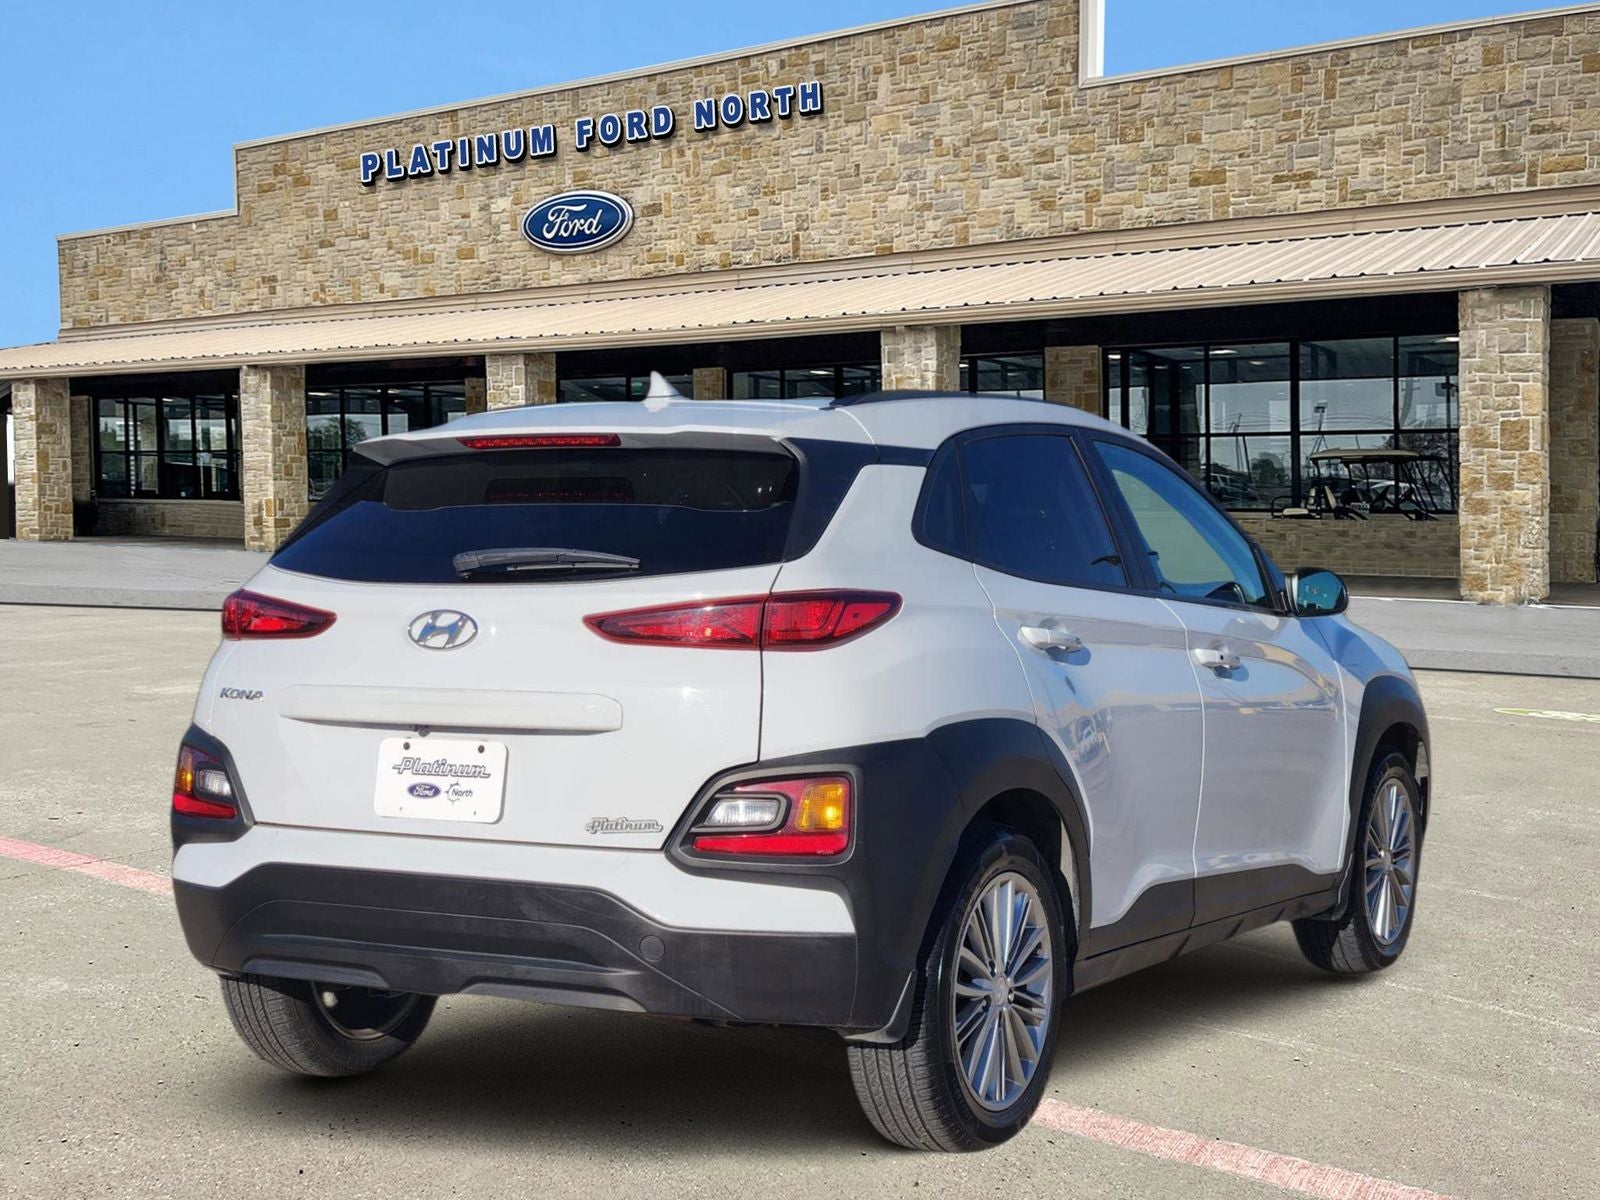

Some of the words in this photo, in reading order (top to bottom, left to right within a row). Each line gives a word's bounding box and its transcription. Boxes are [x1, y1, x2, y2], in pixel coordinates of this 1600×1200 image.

[360, 123, 556, 187] PLATINUM
[575, 104, 674, 151] FORD
[694, 81, 824, 132] NORTH
[542, 203, 603, 239] Ford
[219, 687, 264, 700] KONA
[392, 756, 491, 779] Platinum
[412, 783, 436, 797] Ford
[451, 788, 473, 798] North
[585, 816, 664, 834] Platinum
